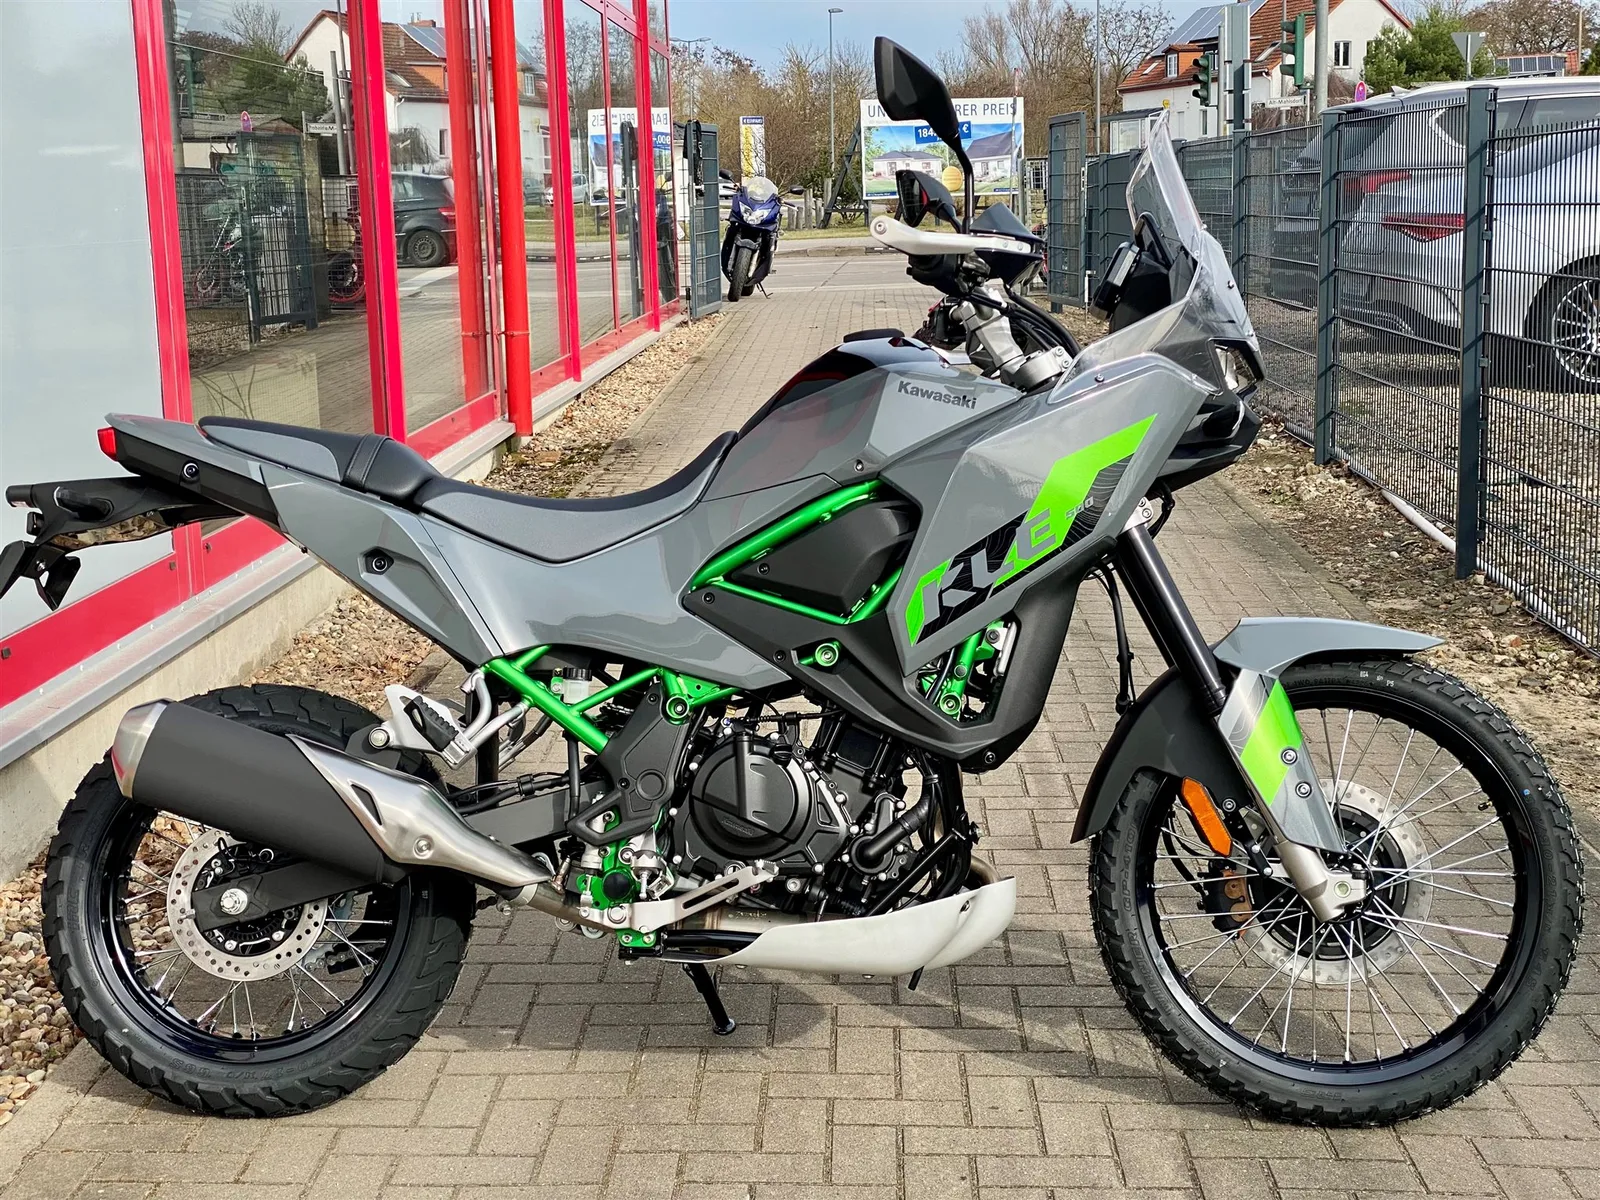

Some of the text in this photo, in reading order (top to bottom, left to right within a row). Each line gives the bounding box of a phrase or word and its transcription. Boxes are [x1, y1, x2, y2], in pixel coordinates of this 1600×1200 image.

[962, 123, 970, 133] €
[897, 380, 977, 409] Kawasaki
[1065, 496, 1094, 520] 500
[921, 508, 1057, 626] KLE
[1121, 828, 1136, 913] GP-410
